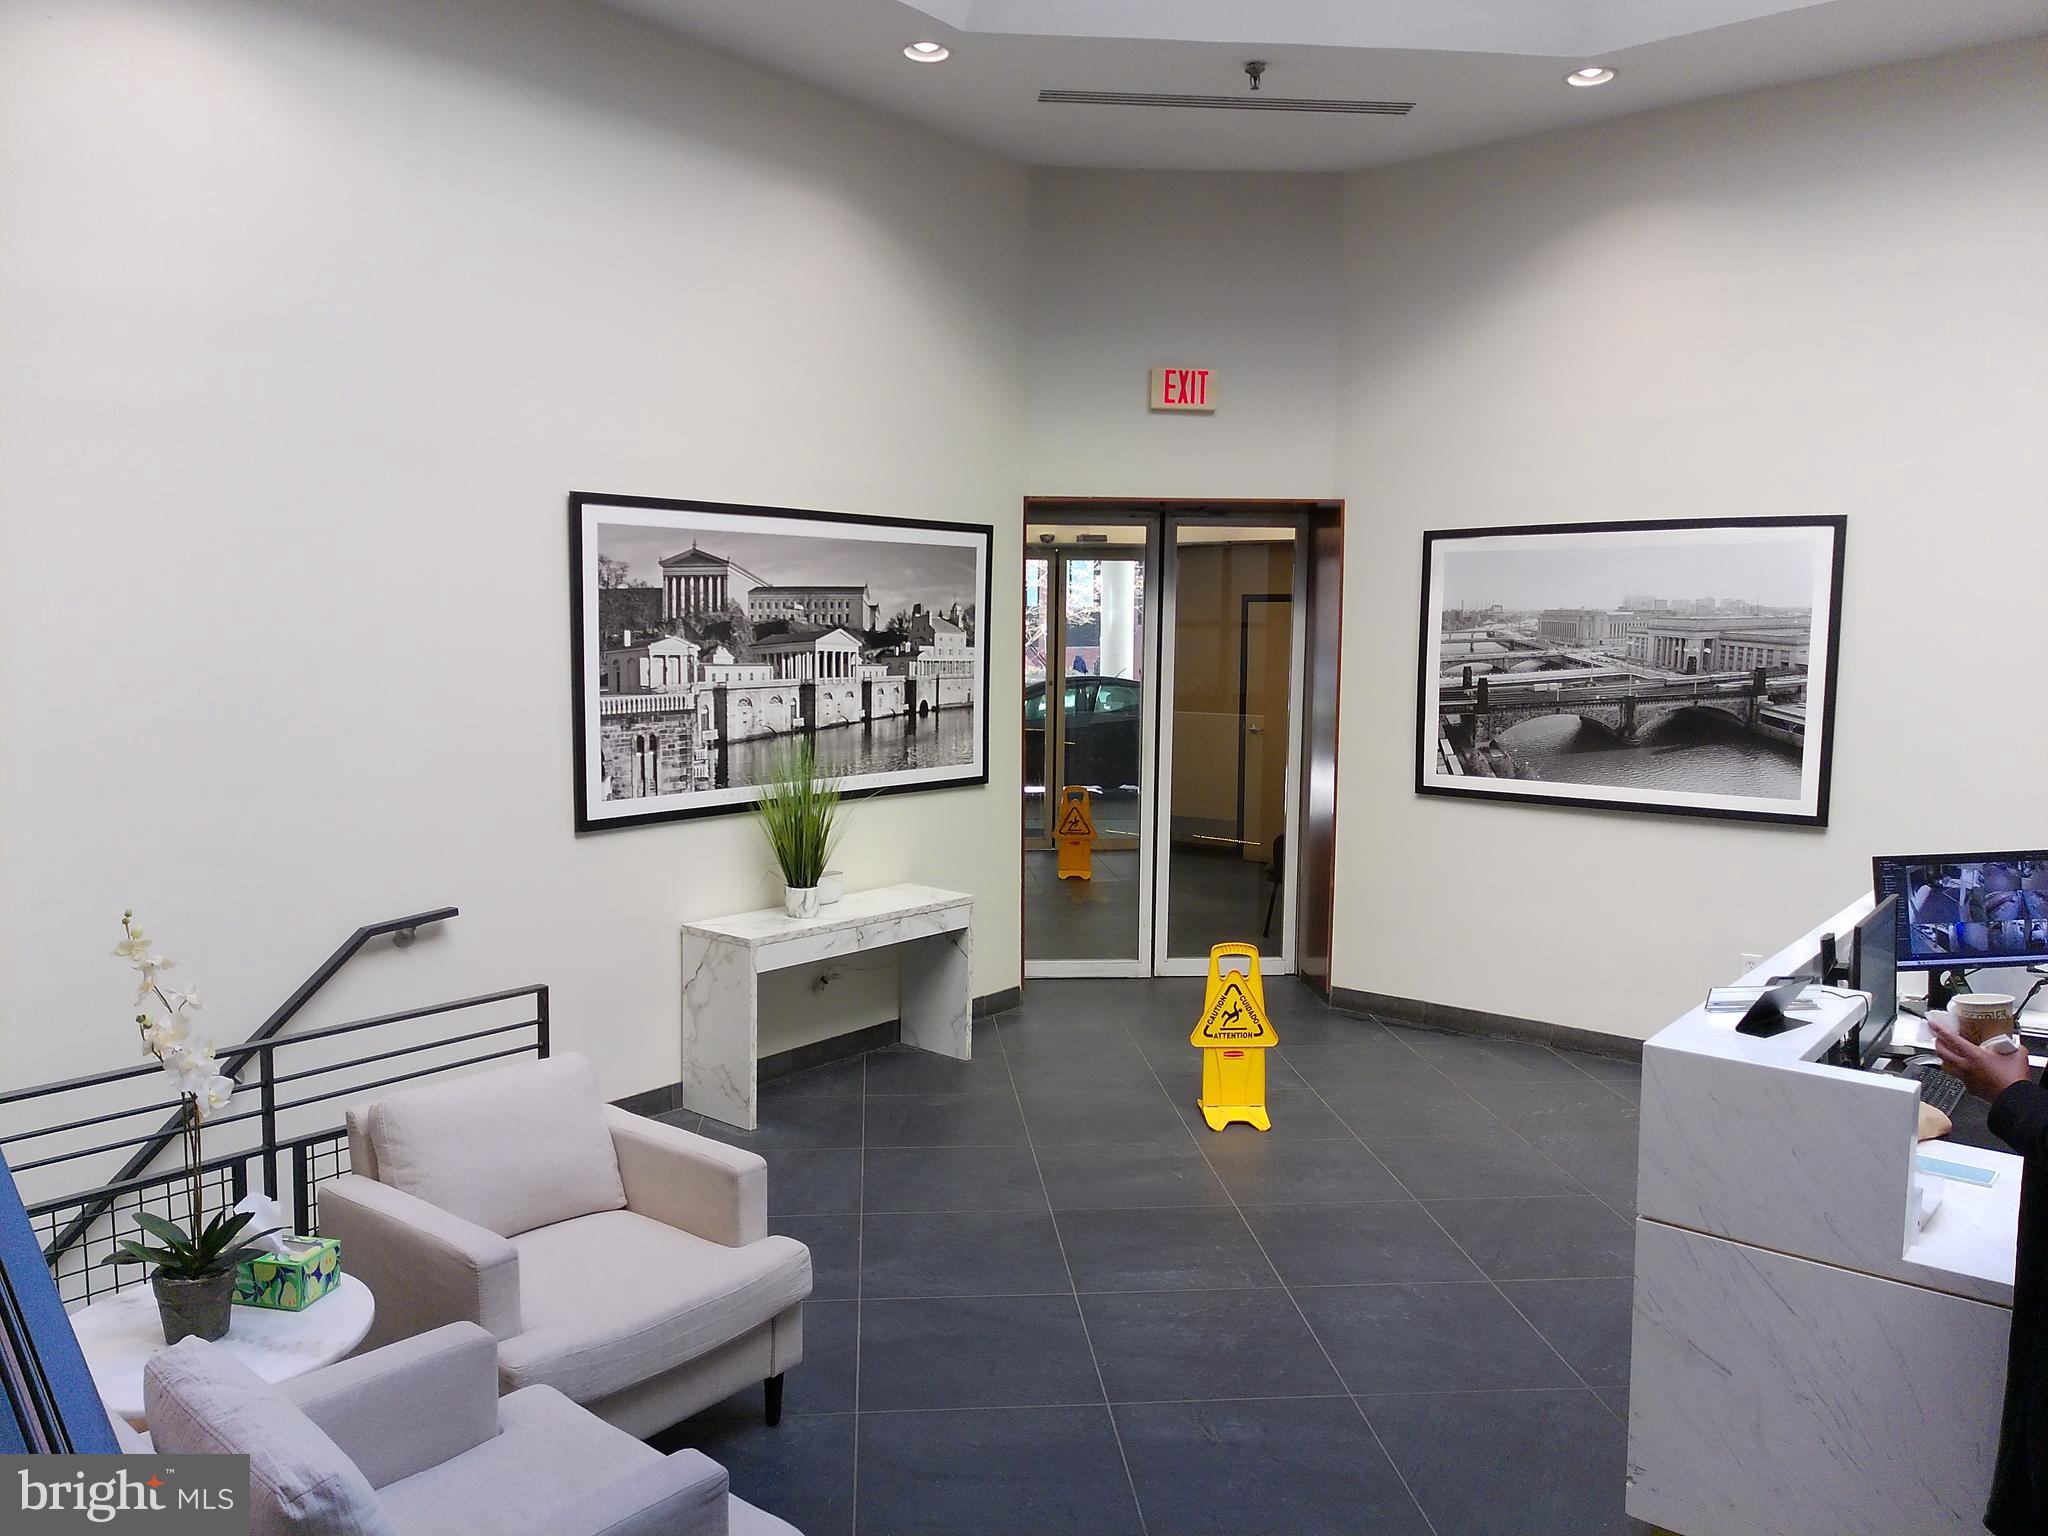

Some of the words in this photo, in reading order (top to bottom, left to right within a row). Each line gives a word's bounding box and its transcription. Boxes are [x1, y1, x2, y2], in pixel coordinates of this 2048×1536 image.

[1164, 369, 1209, 405] EXIT
[1207, 995, 1227, 1025] CAUTION
[1239, 995, 1260, 1025] CUIDADO
